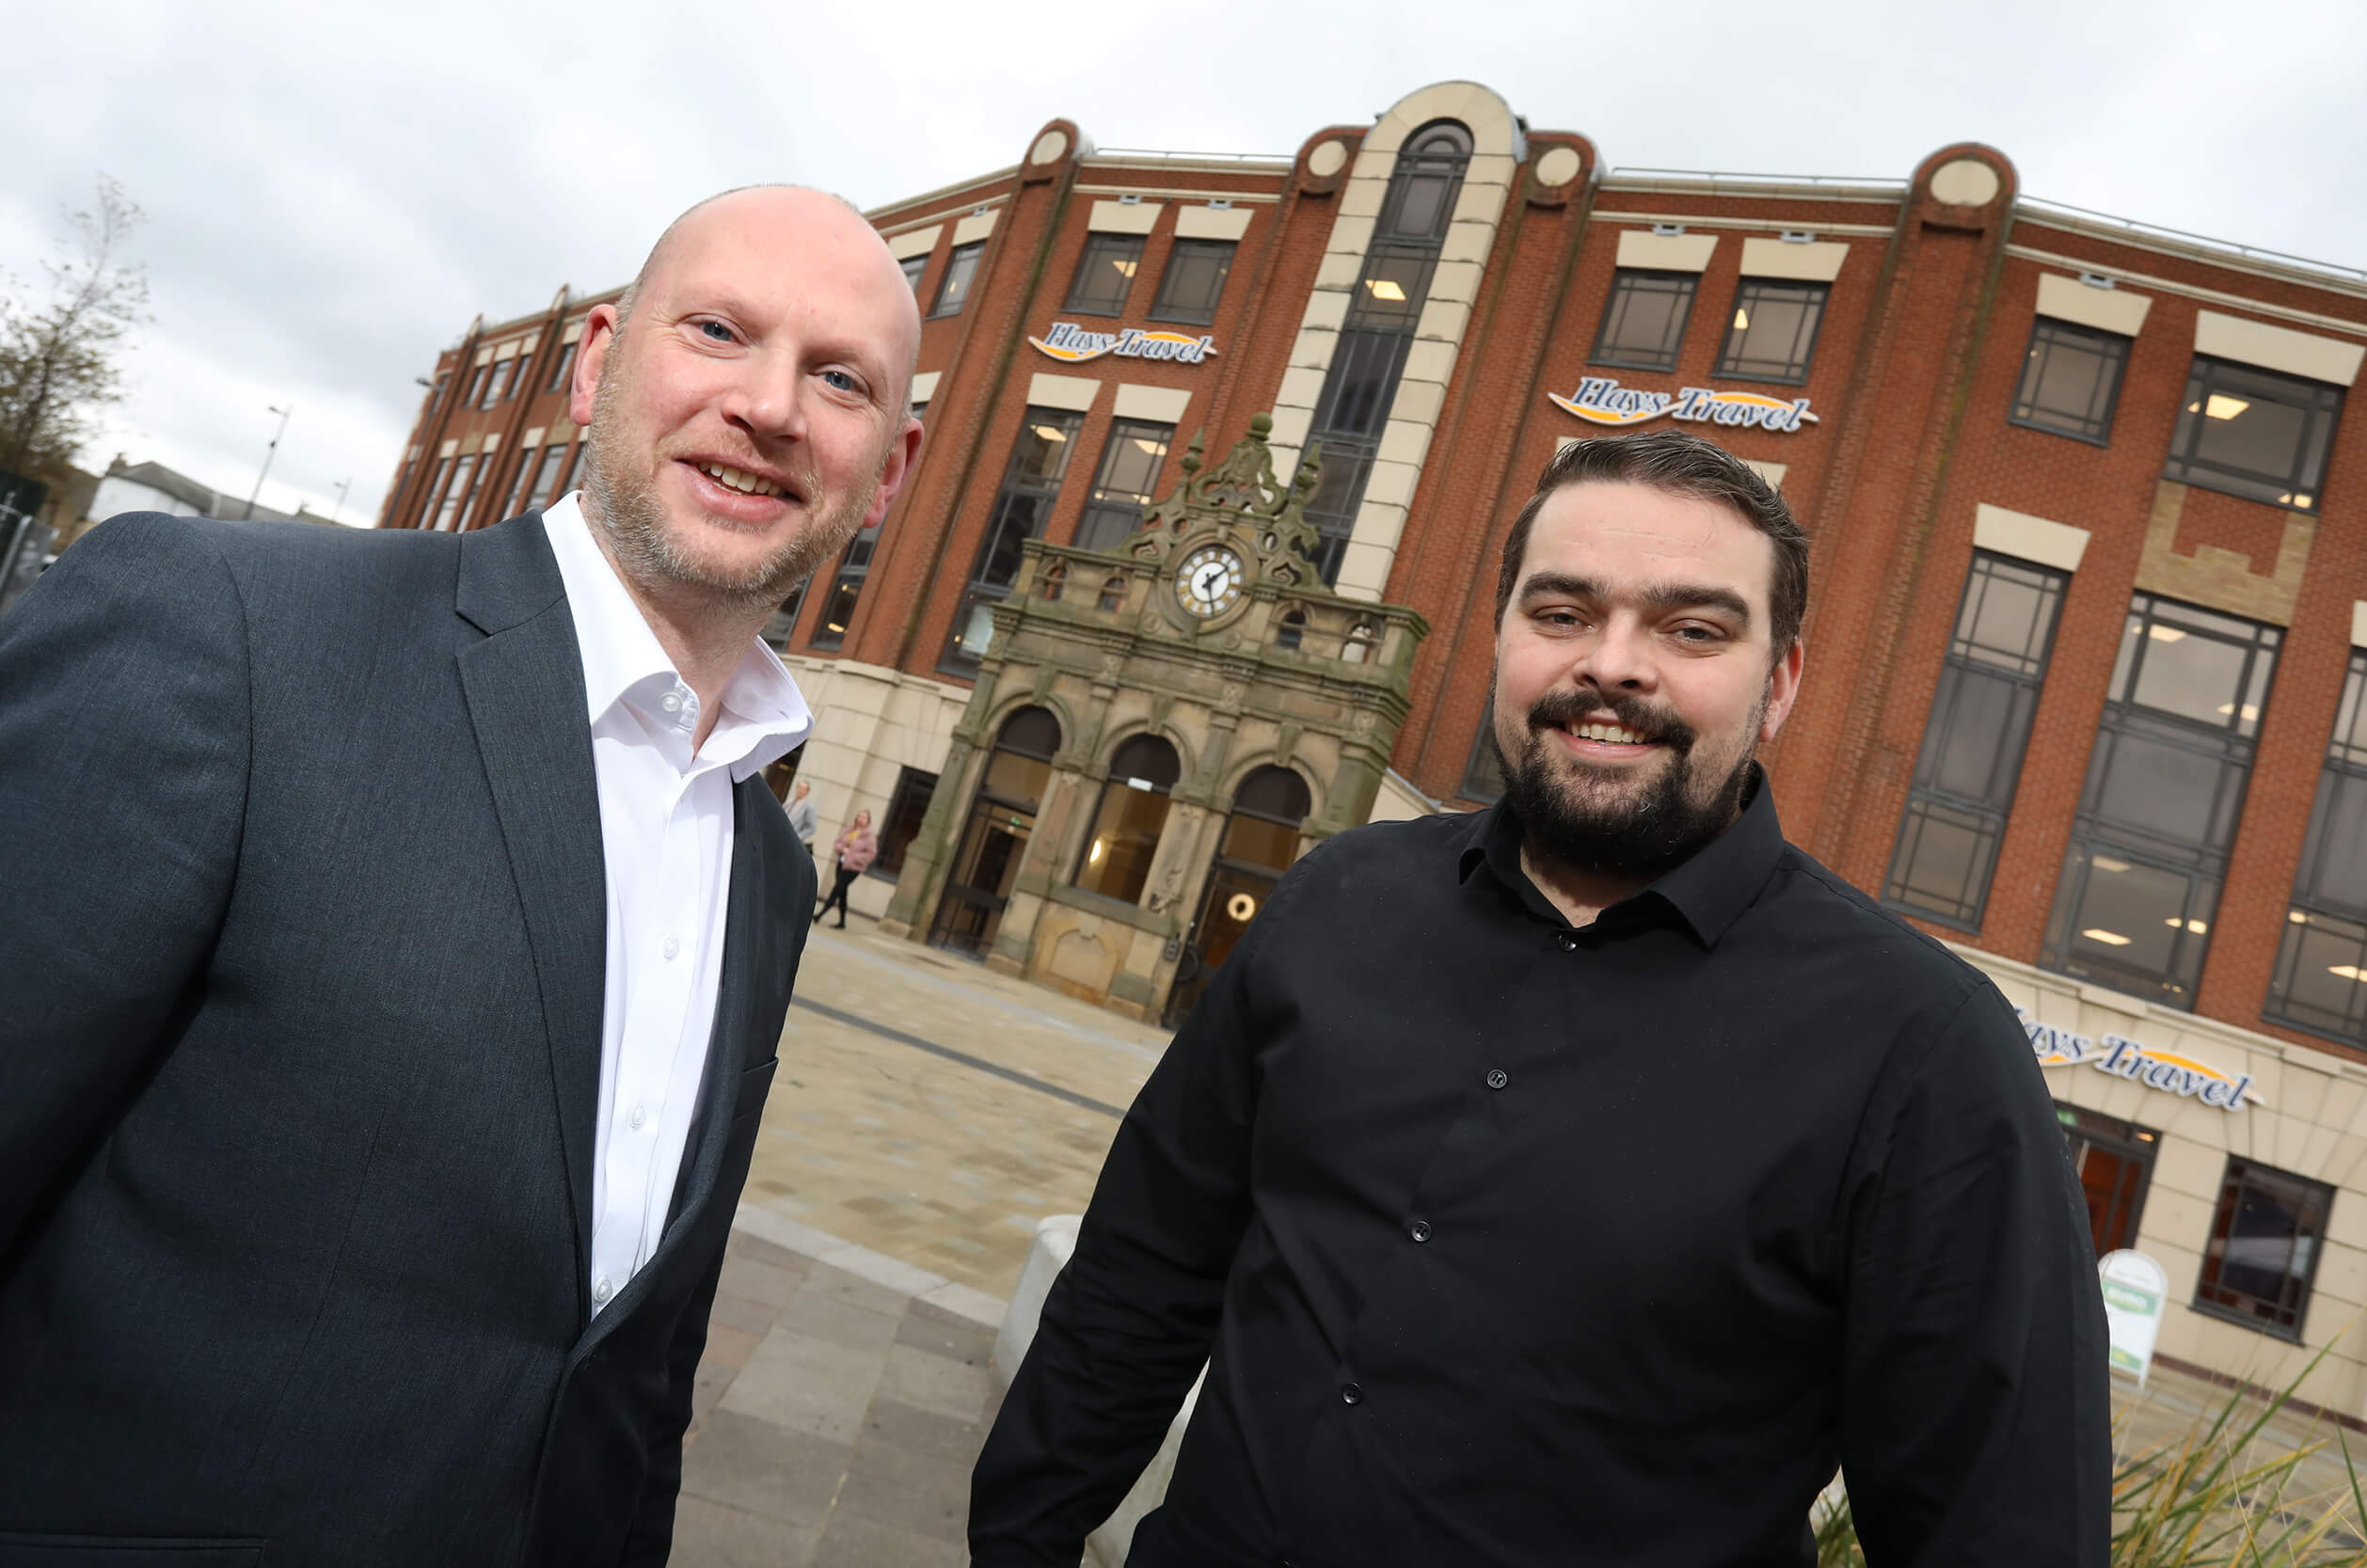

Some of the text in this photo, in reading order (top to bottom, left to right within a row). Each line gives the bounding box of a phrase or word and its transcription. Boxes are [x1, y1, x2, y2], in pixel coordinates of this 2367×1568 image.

[1045, 322, 1209, 362] Hays Travel
[1566, 377, 1805, 430] Hays Travel
[2010, 1006, 2249, 1108] ays Travel
